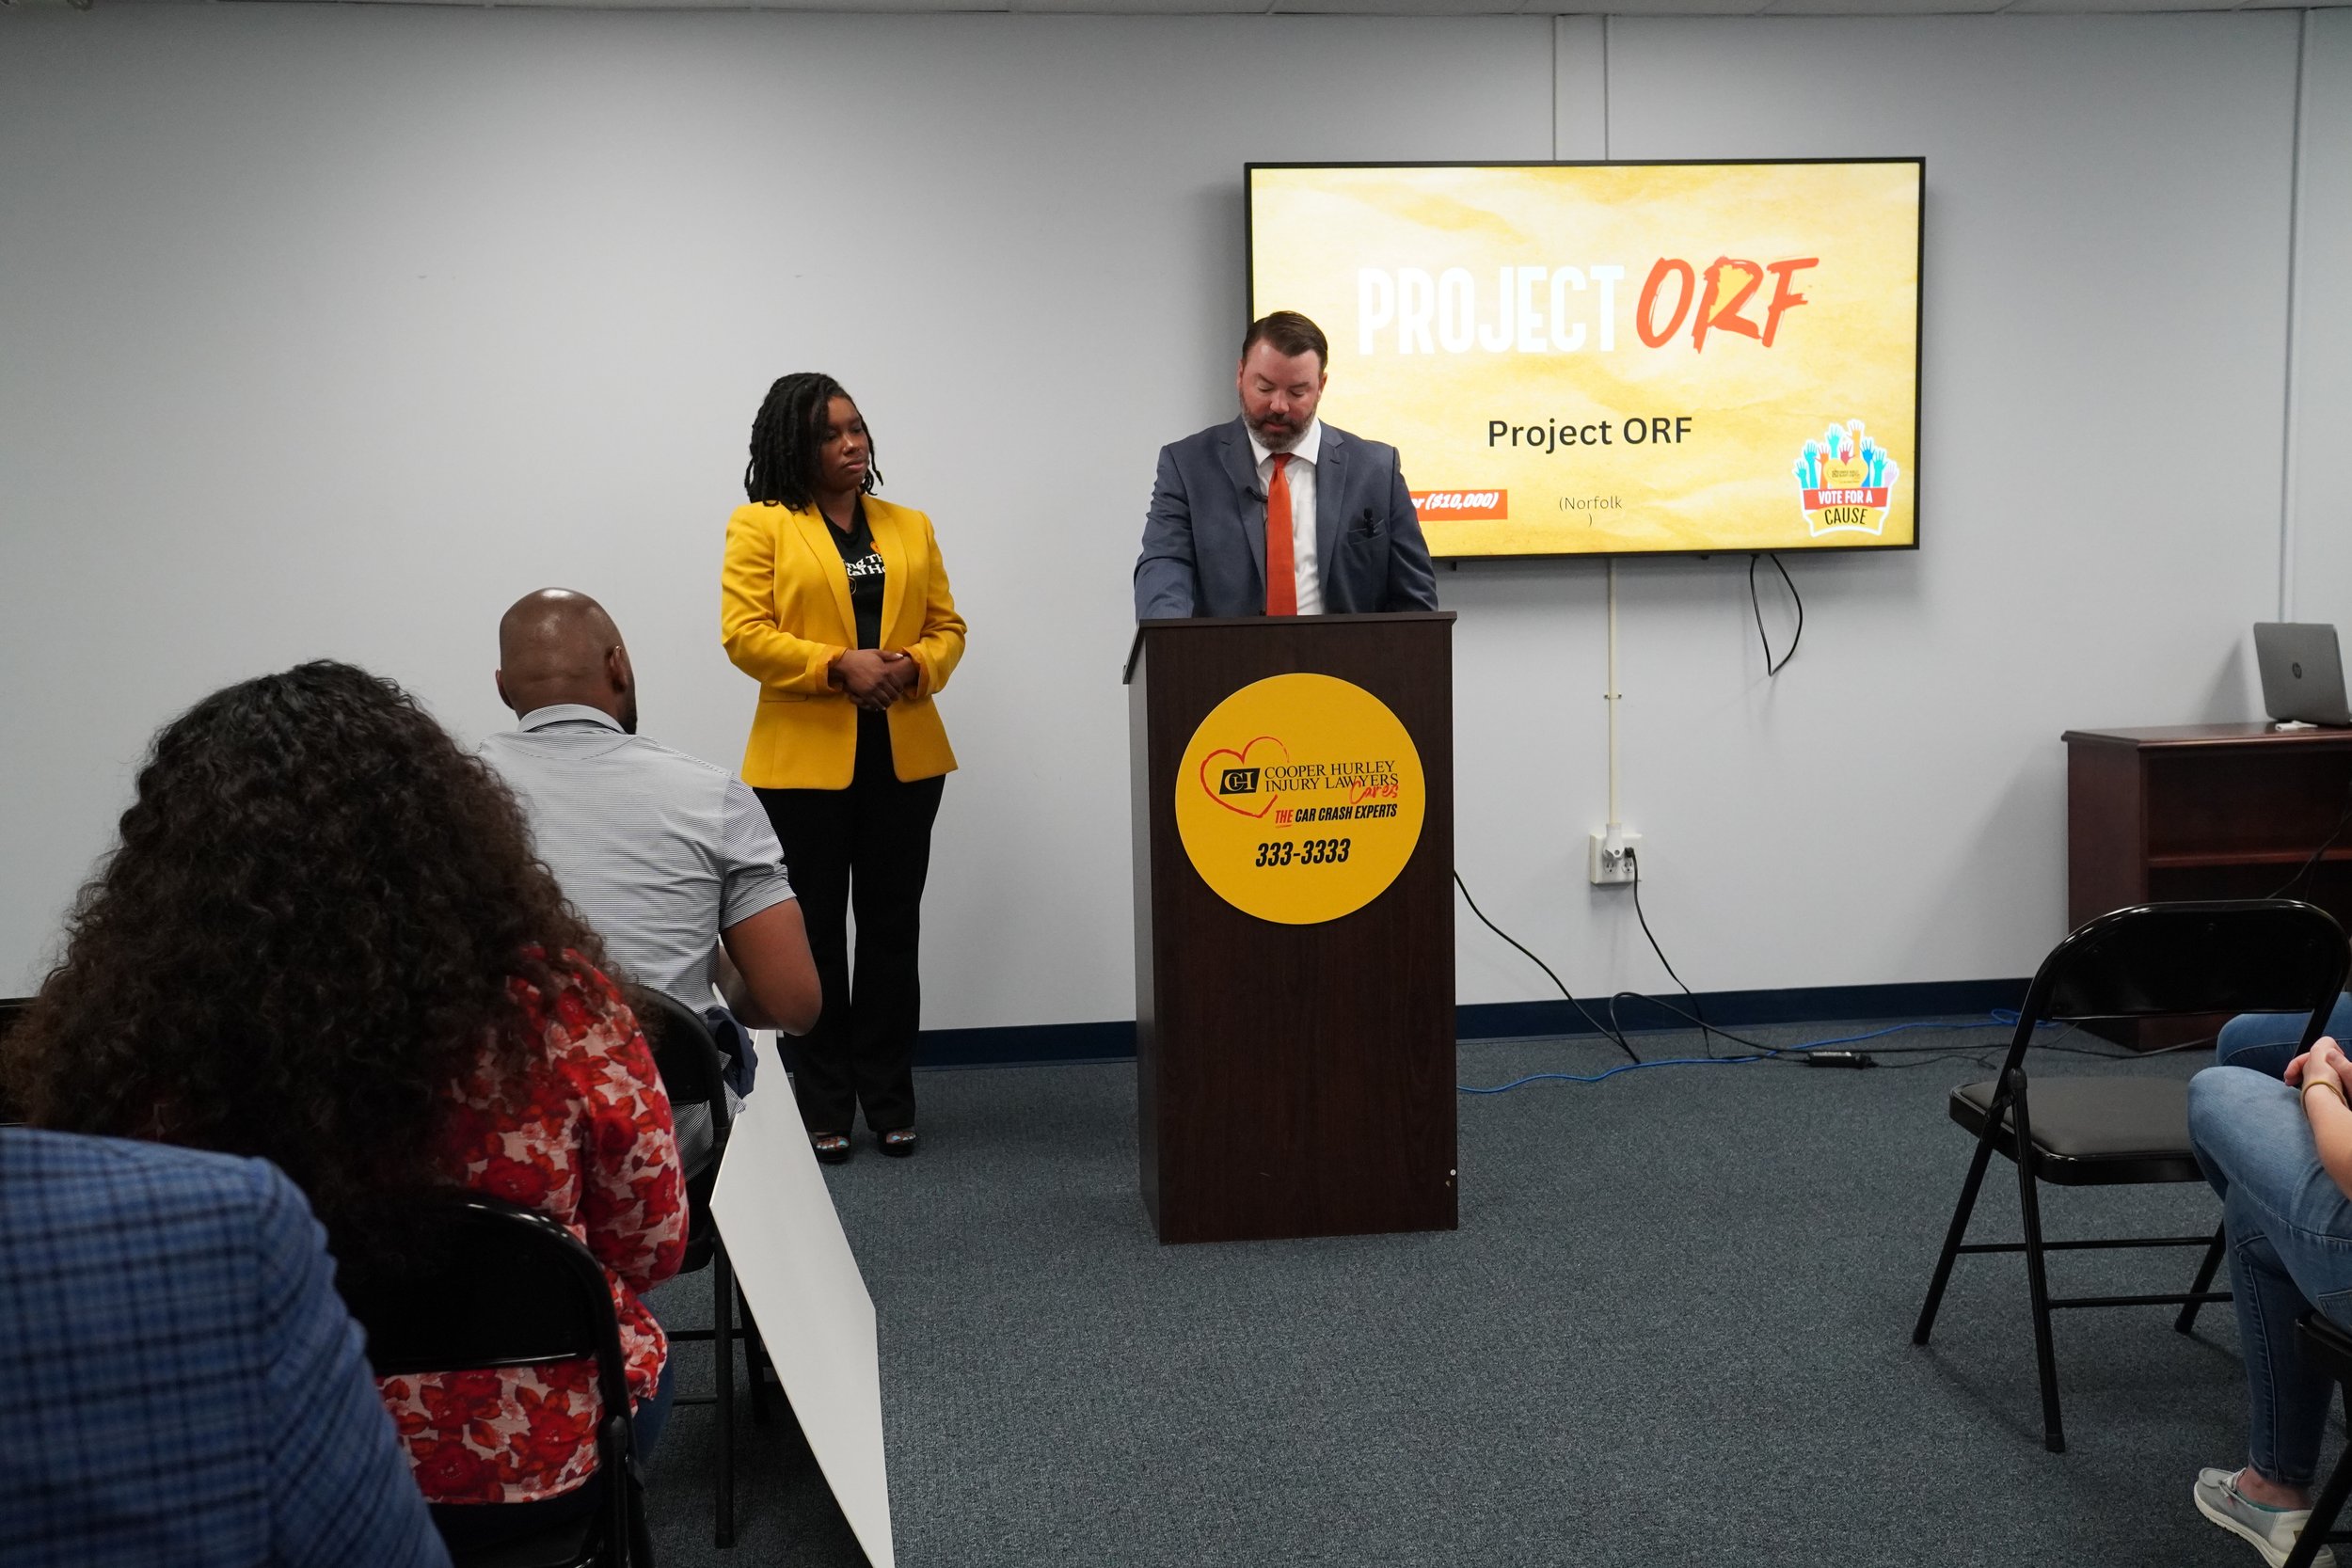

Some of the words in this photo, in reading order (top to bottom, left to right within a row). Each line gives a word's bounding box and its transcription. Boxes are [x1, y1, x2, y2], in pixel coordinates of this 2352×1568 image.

[1357, 264, 1625, 356] PROJECT
[1636, 256, 1820, 354] ORF
[1489, 418, 1613, 454] Project
[1623, 417, 1692, 444] ORF
[1425, 491, 1499, 511] ($10,000)
[1559, 496, 1623, 511] (Norfolk
[1818, 490, 1843, 504] VOTE
[1845, 489, 1864, 503] FOR
[1866, 489, 1873, 503] A
[1824, 507, 1867, 525] CAUSE
[1264, 764, 1326, 780] COOPER
[1331, 760, 1395, 775] HURLEY
[1265, 777, 1320, 792] INJURY
[1326, 773, 1399, 789] LAWYERS
[1349, 780, 1399, 804] Cares
[1275, 809, 1294, 824] THE
[1295, 808, 1316, 823] CAR
[1318, 805, 1352, 821] CRASH
[1355, 803, 1398, 819] EXPERTS
[1255, 838, 1351, 867] 333-3333
